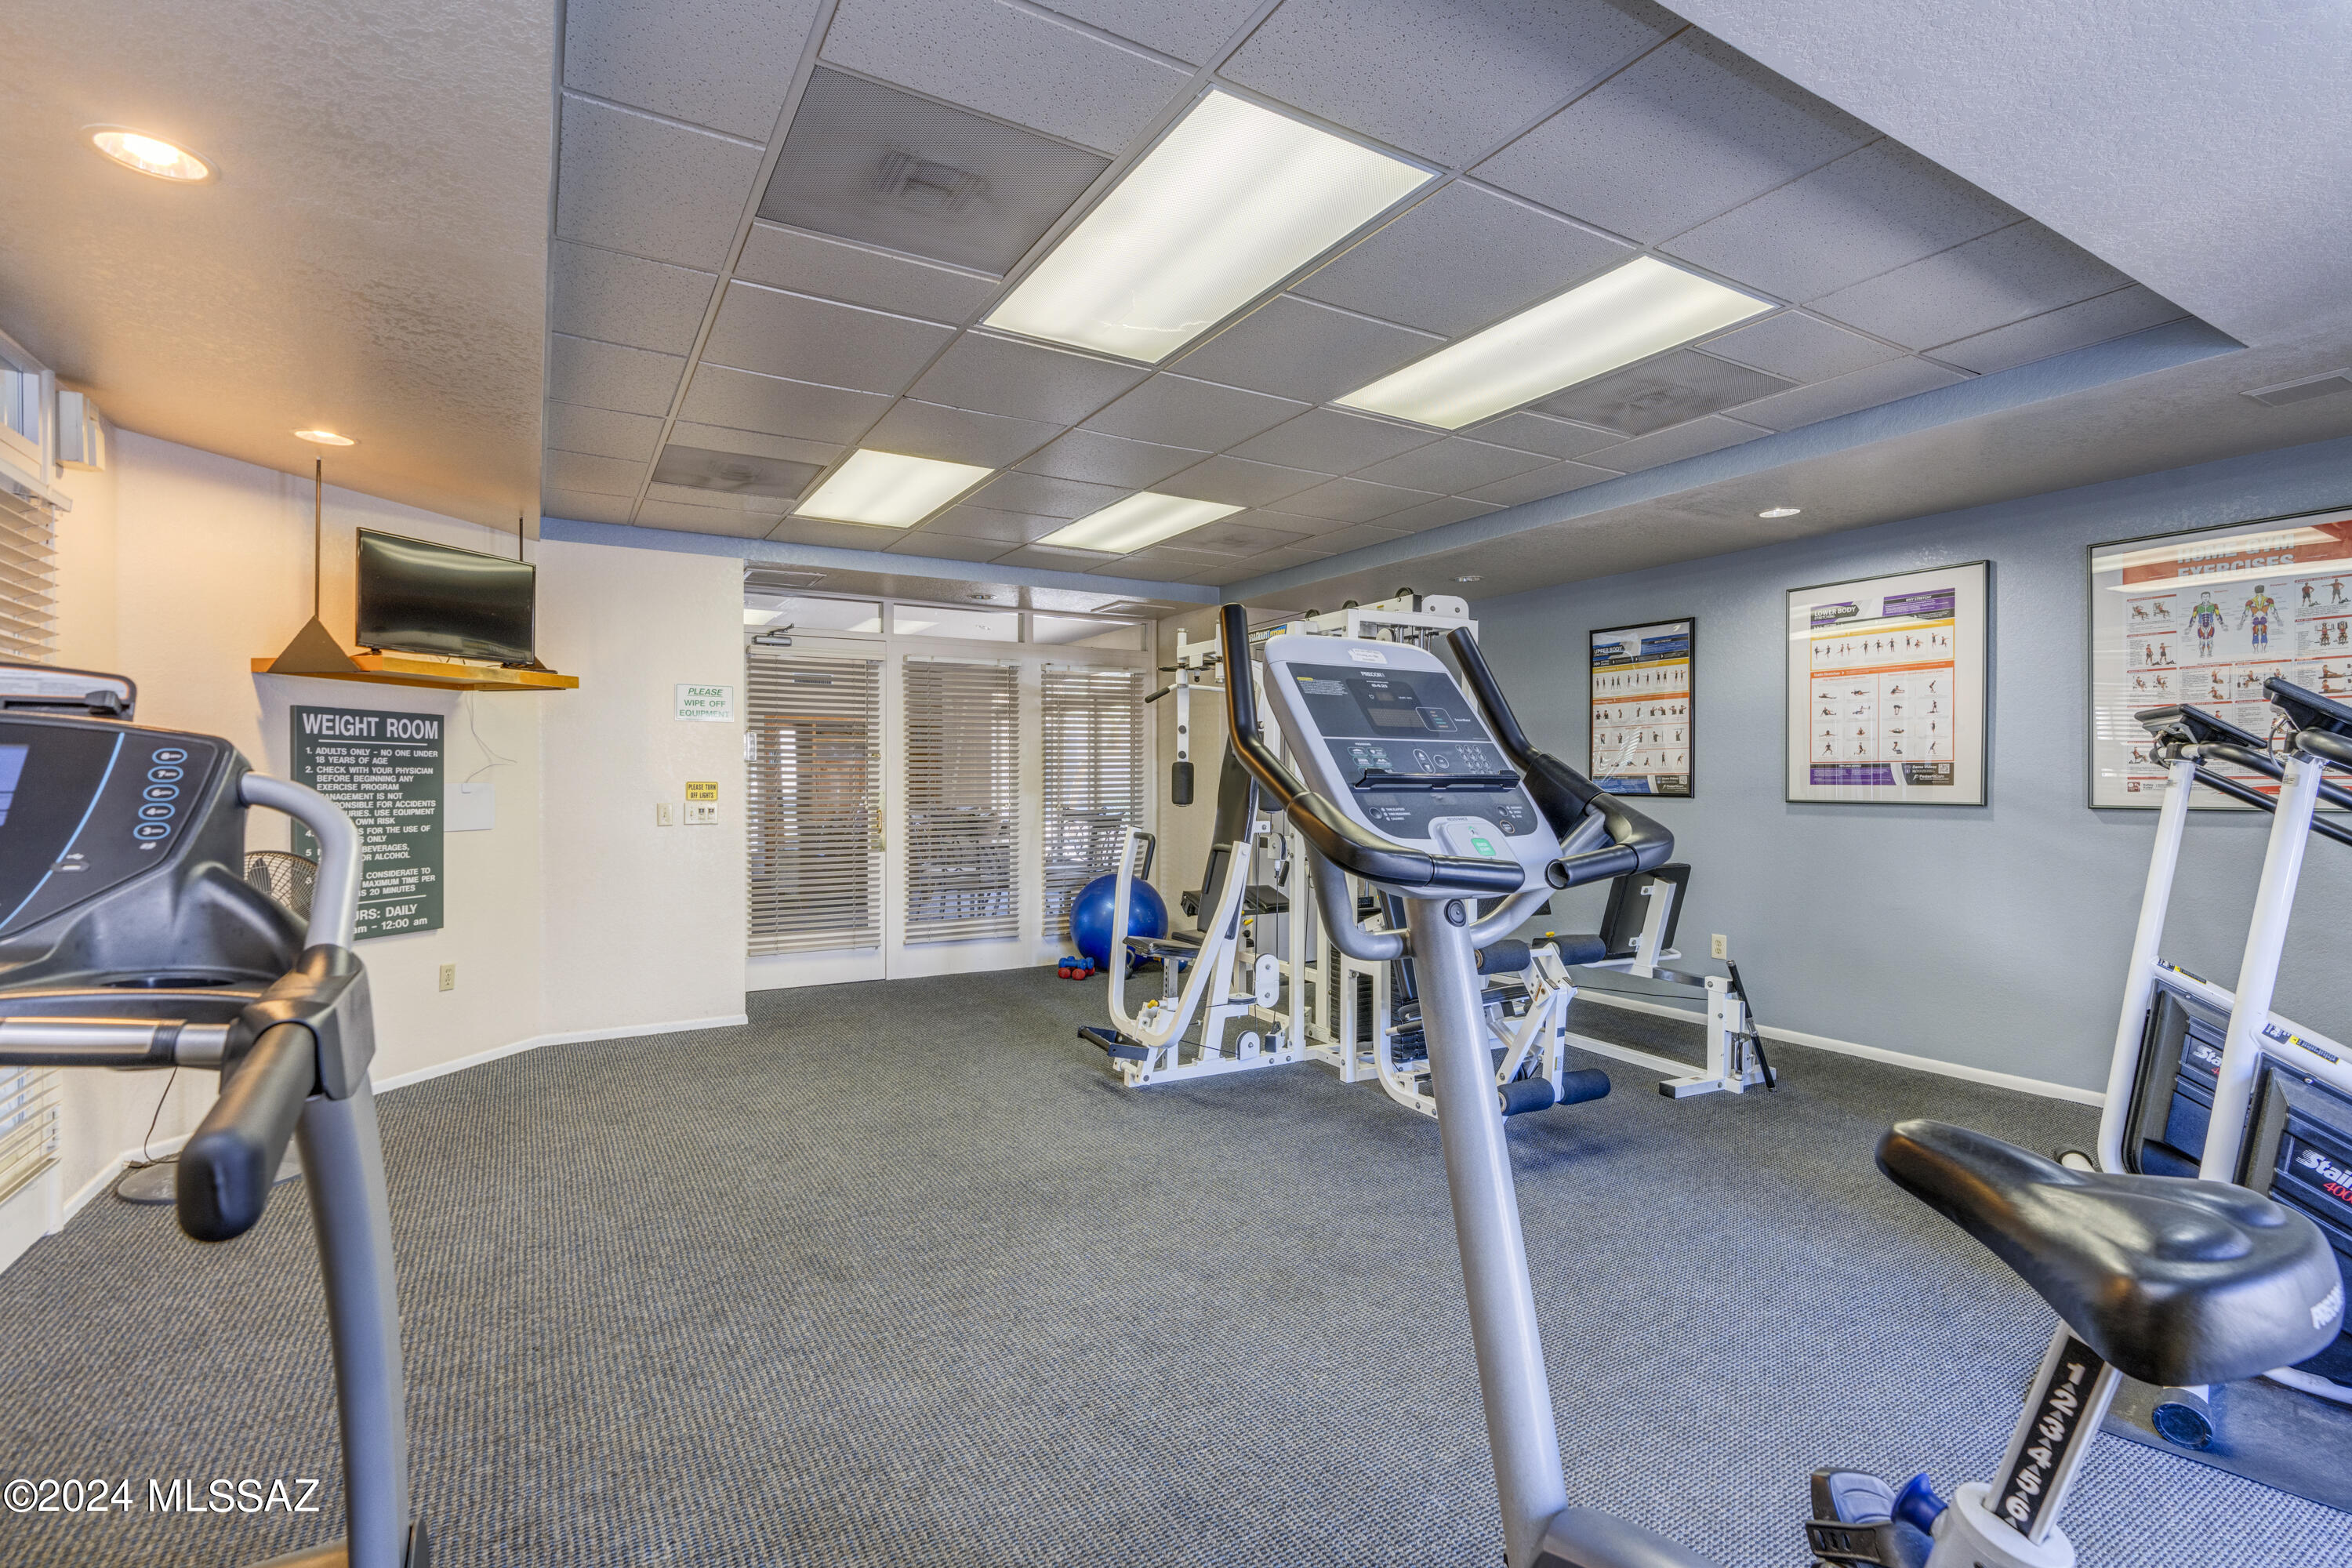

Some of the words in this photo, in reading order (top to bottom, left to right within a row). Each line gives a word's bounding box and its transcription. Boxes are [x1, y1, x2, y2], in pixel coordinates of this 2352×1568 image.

[302, 713, 379, 737] WEIGHT
[387, 718, 438, 739] ROOM
[361, 844, 410, 853] BEVERAGES,
[375, 851, 411, 860] ALCOHOL
[362, 877, 399, 888] MAXIMUM
[401, 876, 419, 884] TIME
[366, 869, 419, 879] CONSIDERATE
[383, 884, 416, 895] MINUTES
[354, 909, 381, 921] URS:
[386, 904, 418, 917] DAILY
[381, 919, 409, 931] 12:00
[413, 917, 427, 926] am
[2322, 1182, 2352, 1205] 400
[2067, 1363, 2085, 1385] 1
[2049, 1388, 2078, 1417] 2
[2038, 1416, 2065, 1442] 3
[2027, 1446, 2053, 1469] 4
[2016, 1468, 2042, 1496] 5
[2005, 1495, 2031, 1522] 6
